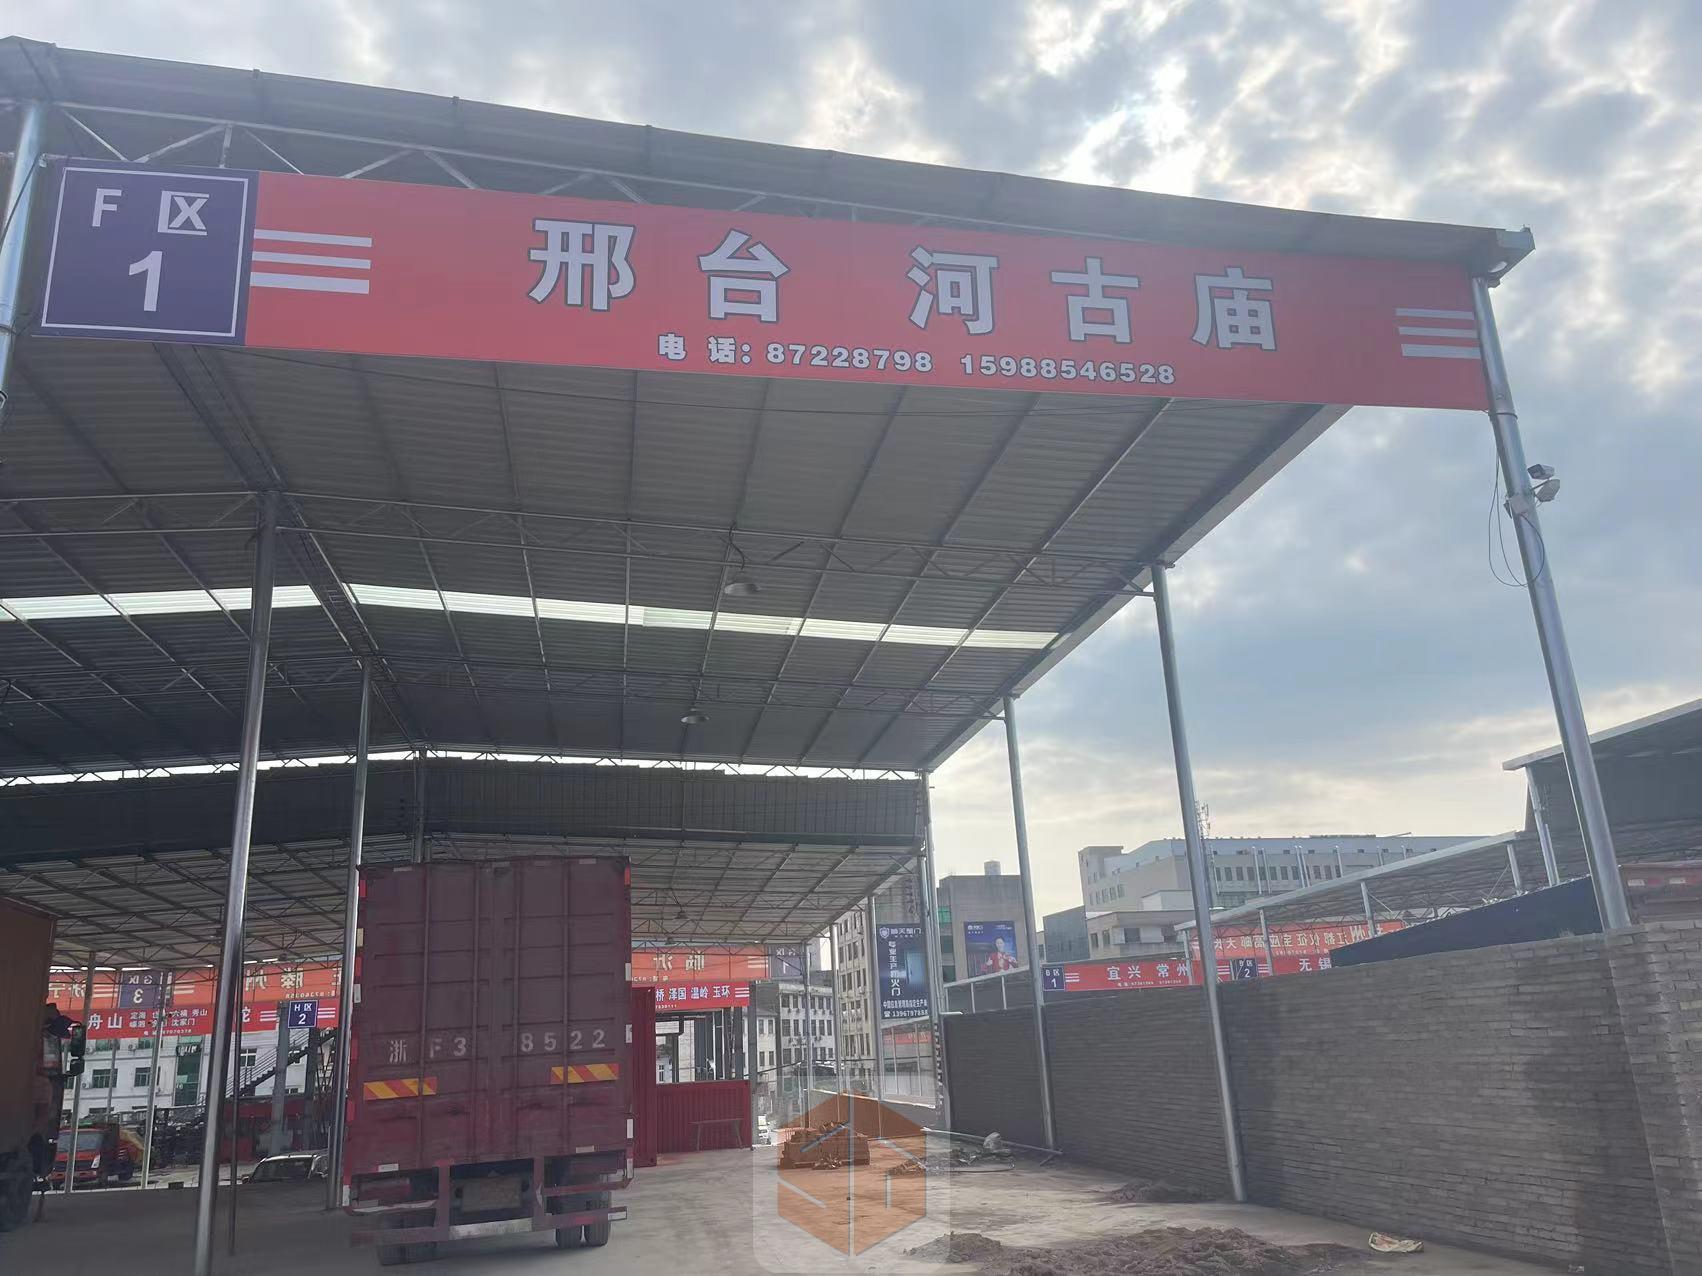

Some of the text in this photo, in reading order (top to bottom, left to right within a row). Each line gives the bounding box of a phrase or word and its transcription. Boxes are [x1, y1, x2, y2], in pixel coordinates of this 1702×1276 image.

[128, 250, 163, 312] 1
[766, 343, 933, 373] 87228798
[960, 353, 1176, 386] 15988546528
[1244, 968, 1251, 978] 2
[1051, 978, 1057, 988] 1
[298, 1013, 307, 1025] 2
